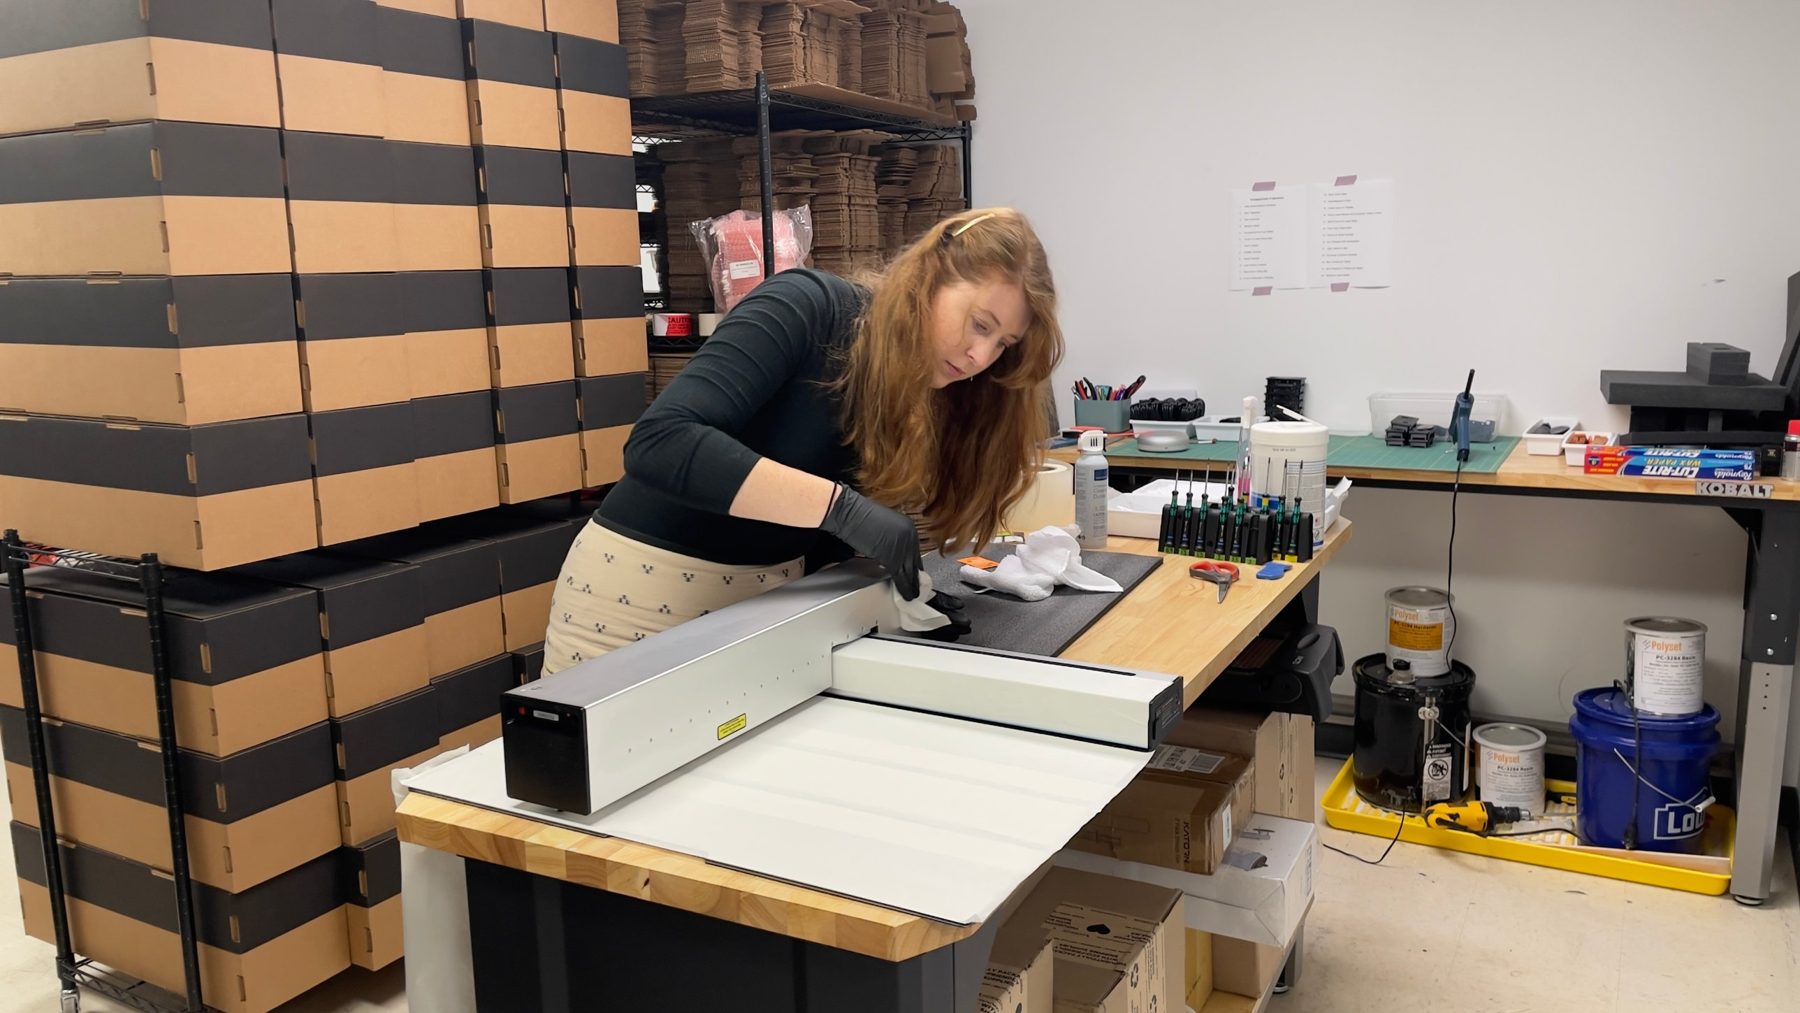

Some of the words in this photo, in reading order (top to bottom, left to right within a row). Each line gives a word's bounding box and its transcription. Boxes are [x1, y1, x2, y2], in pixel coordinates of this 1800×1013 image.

[1647, 458, 1677, 466] PAPER
[1680, 459, 1700, 467] WAX
[1641, 465, 1700, 478] CUT-RITE
[1714, 468, 1752, 480] Reynolds
[1697, 481, 1774, 498] KOBALT
[1651, 640, 1682, 653] Polyset
[1493, 752, 1520, 765] Polyset
